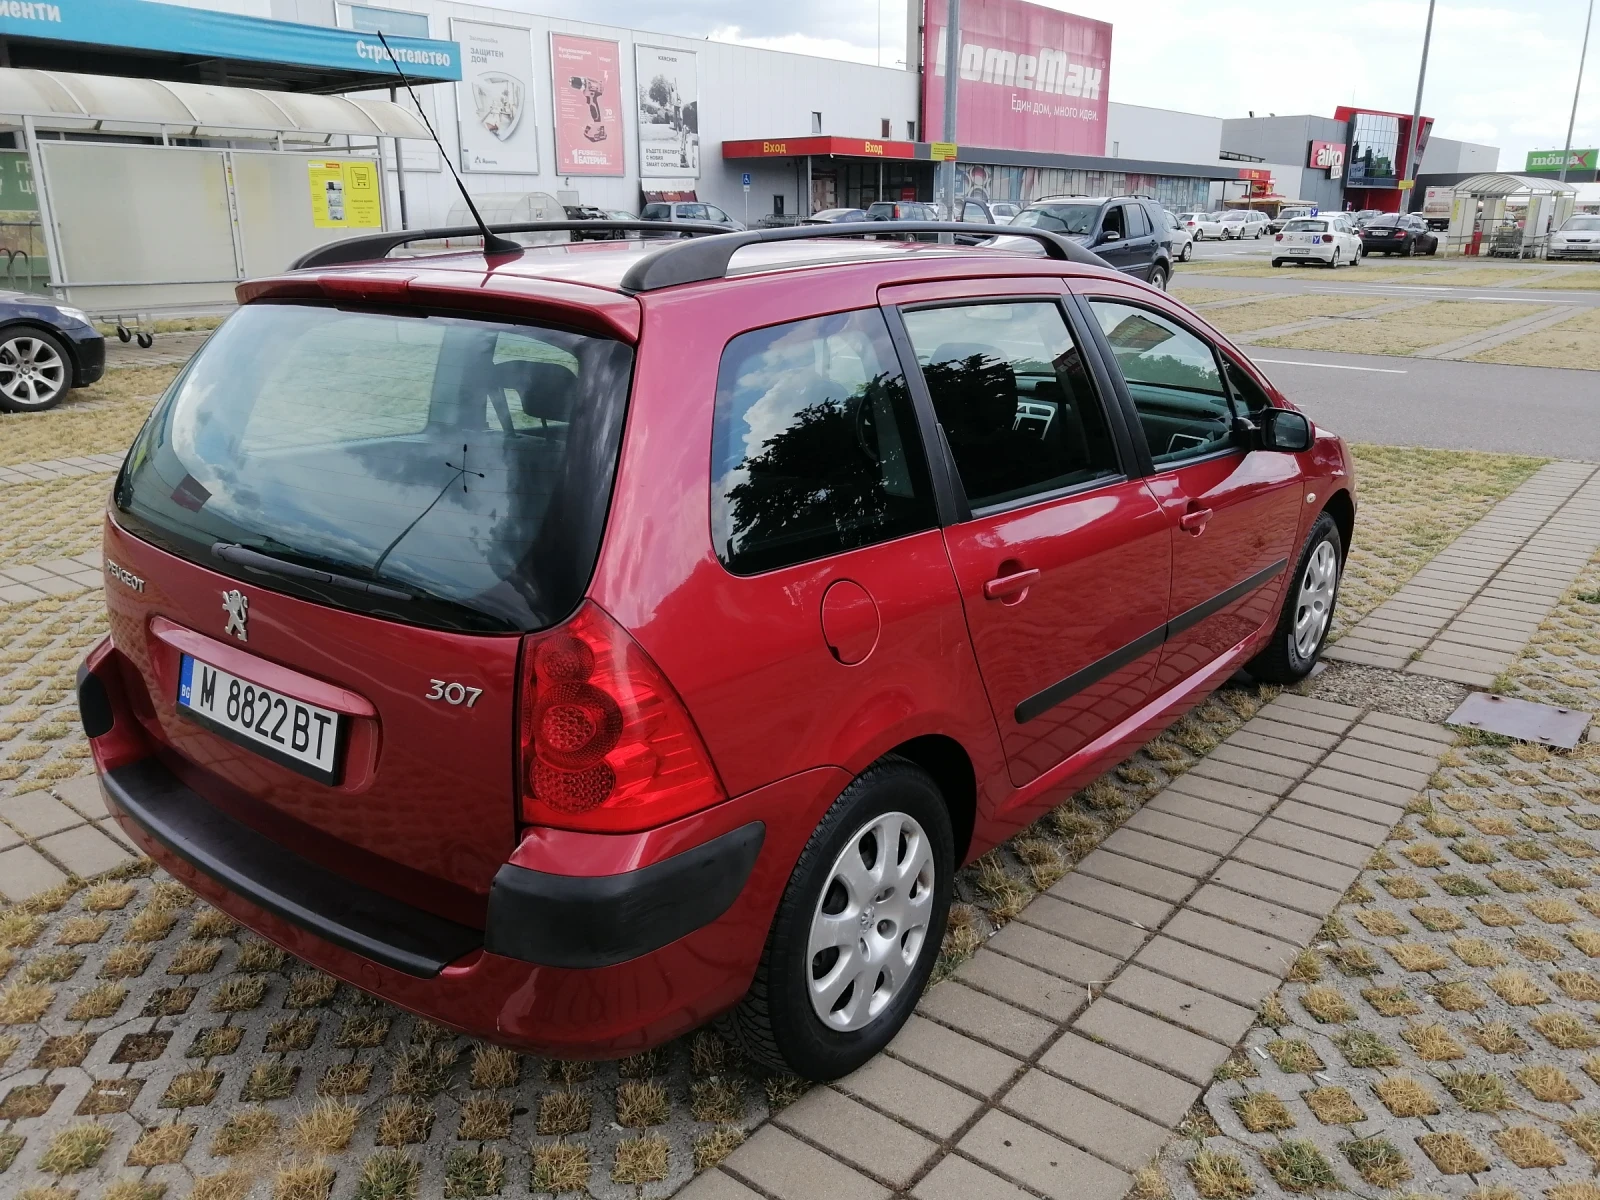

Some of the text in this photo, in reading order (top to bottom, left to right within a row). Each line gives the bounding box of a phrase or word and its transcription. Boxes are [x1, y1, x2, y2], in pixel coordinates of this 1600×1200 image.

[356, 40, 451, 67] Строителство
[470, 47, 504, 58] ЗАЩИТЕН
[471, 55, 488, 64] ДОМ
[1011, 93, 1099, 122] Един дом, много идеи.
[763, 141, 787, 155] Вход
[864, 141, 884, 155] Вход
[1316, 144, 1343, 167] aiko
[107, 558, 145, 593] PEUGEOT
[181, 684, 191, 699] BG
[200, 666, 217, 711] M
[425, 678, 483, 708] 307
